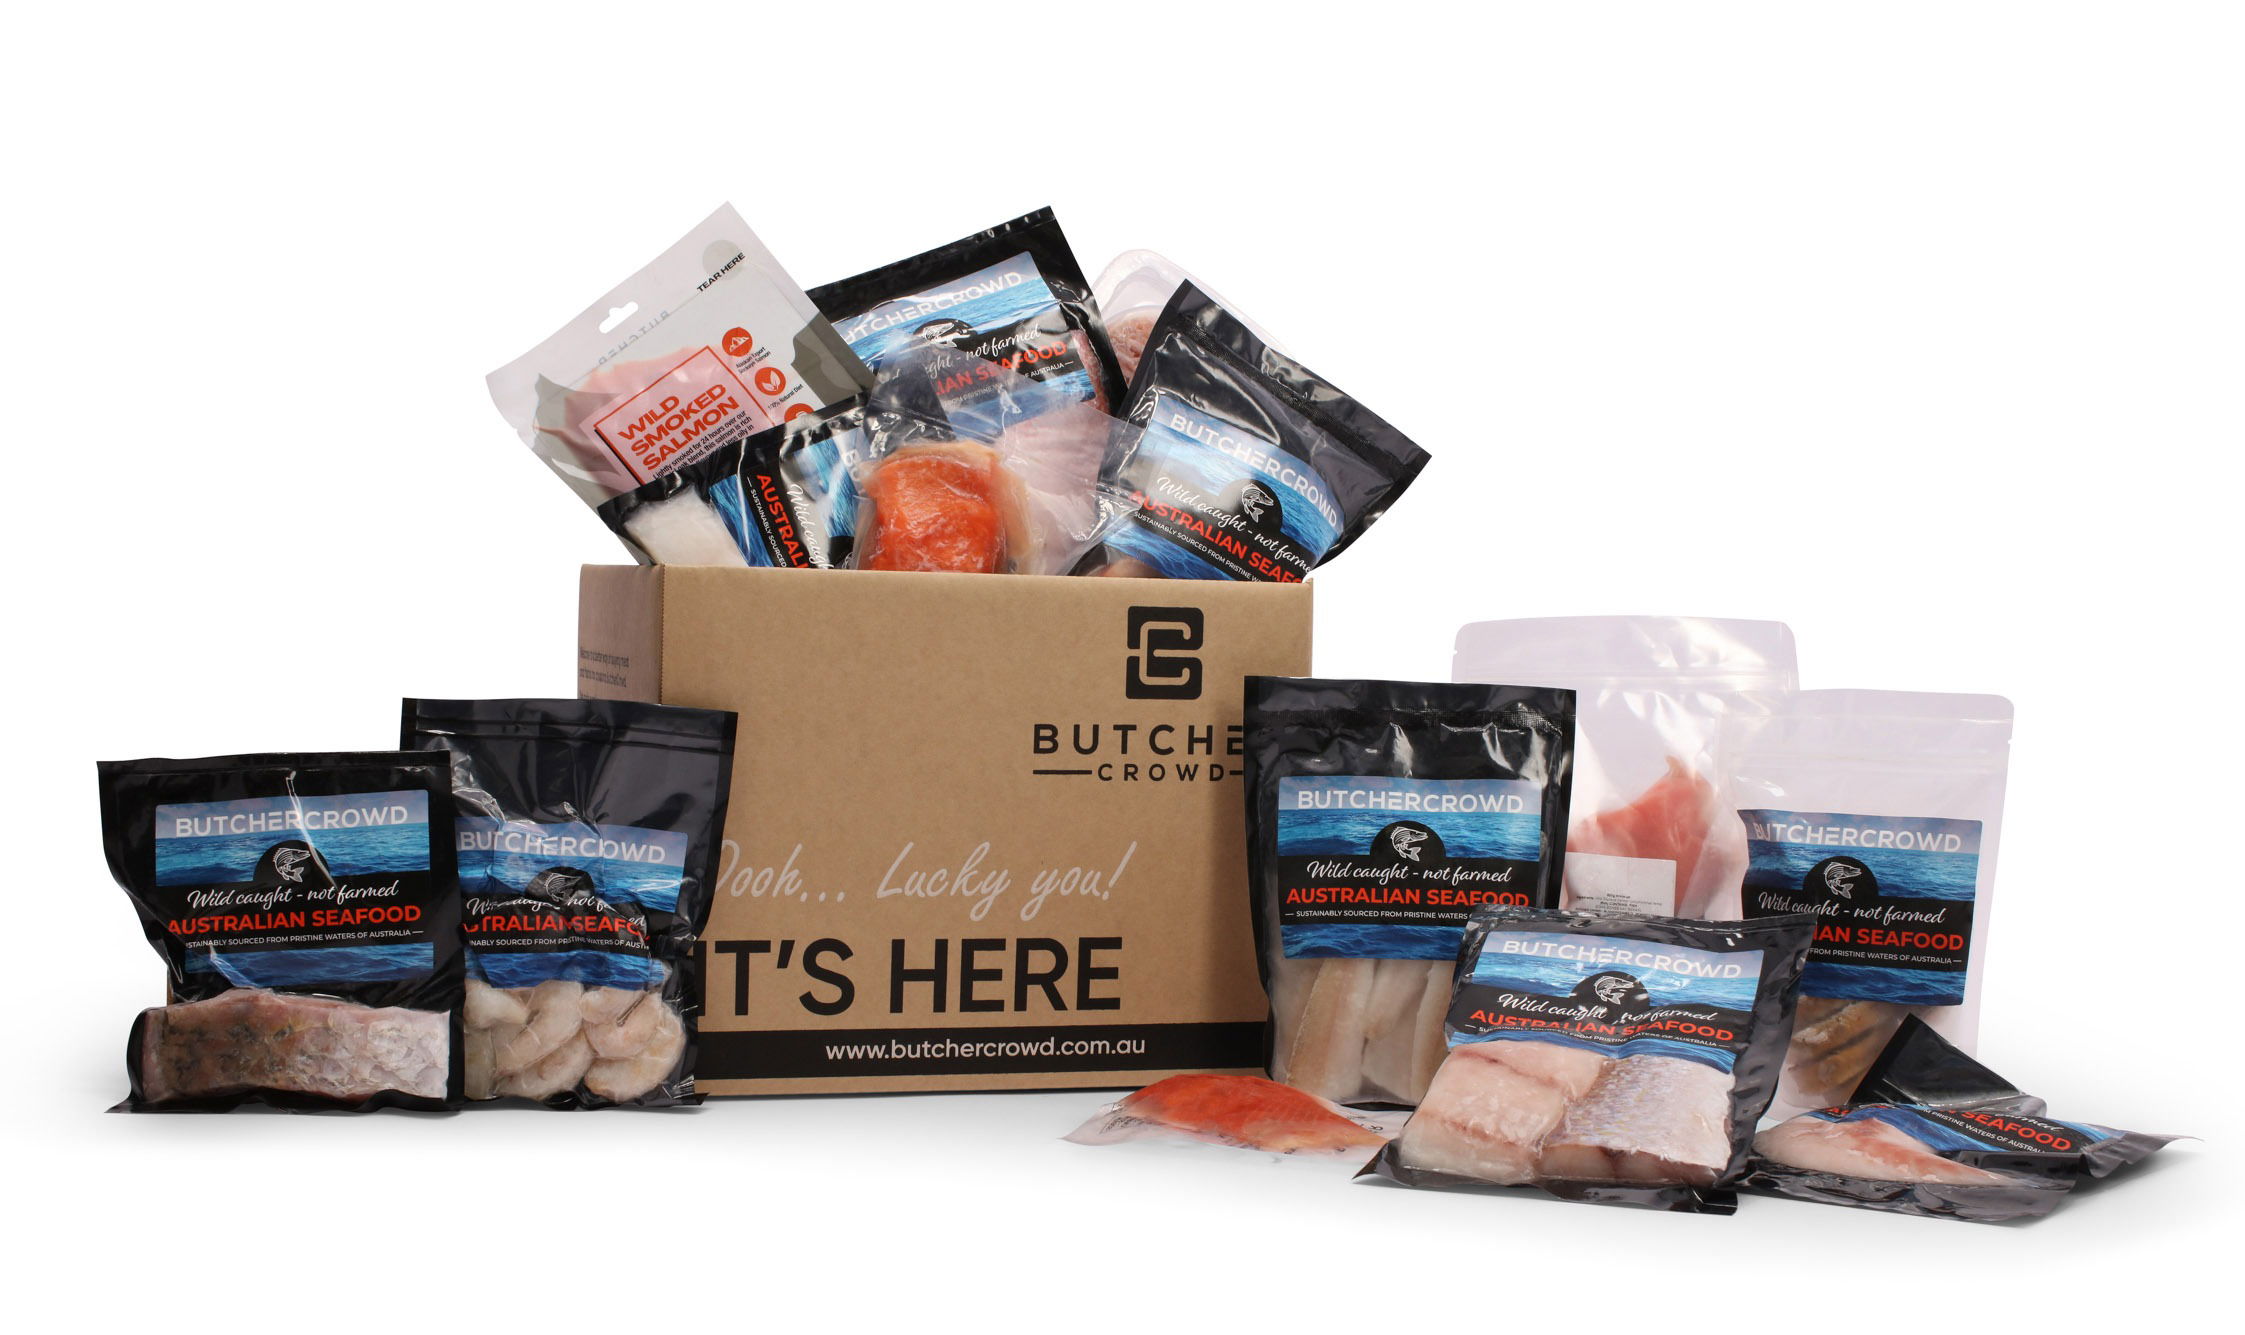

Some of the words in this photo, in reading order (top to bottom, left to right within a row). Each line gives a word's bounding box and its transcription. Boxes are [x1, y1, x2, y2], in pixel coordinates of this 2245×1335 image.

[697, 272, 722, 292] TEAR
[720, 252, 746, 275] HERE
[844, 271, 1022, 343] UTCHERCROWD
[965, 340, 990, 359] not
[992, 324, 1041, 356] farmed
[1030, 363, 1065, 378] AUSTRALIA
[618, 396, 680, 440] WILD
[631, 384, 726, 456] SMOKED
[642, 396, 739, 470] SALMON
[705, 441, 715, 451] this
[715, 428, 735, 444] salmon
[741, 416, 751, 426] rich
[737, 428, 748, 438] oily
[652, 463, 673, 480] Lightly
[671, 447, 693, 465] smoked
[693, 441, 702, 450] for
[701, 436, 709, 444] 24
[709, 425, 725, 439] hours
[725, 417, 737, 428] over
[737, 411, 746, 419] our
[1168, 413, 1337, 528] BUTCHERCROWD
[750, 488, 772, 536] SUSTAINABLY
[768, 535, 787, 568] SOURCED
[757, 475, 809, 568] AUSTRALI
[787, 484, 815, 529] Wild
[804, 530, 834, 569] caugh
[1130, 490, 1248, 559] AUSTRALIAN
[1248, 551, 1302, 583] SEAF
[1157, 476, 1195, 506] Wild
[1197, 501, 1246, 532] caught
[1254, 533, 1279, 551] not
[1274, 545, 1312, 574] farme
[1134, 511, 1177, 535] SUSTAINABLY
[1177, 531, 1208, 552] SOURCED
[1207, 547, 1226, 564] FROM
[1225, 559, 1252, 580] PRISTINE
[1033, 723, 1244, 756] BUTCHE
[1097, 763, 1225, 782] CROWD
[1298, 790, 1524, 813] BUTCHERCROWD
[175, 806, 408, 838] BUTCHERCROWD
[1755, 823, 1961, 853] BUTCHERCROWD
[459, 831, 666, 864] BUTCHERCOWD
[876, 841, 1012, 922] Lucky
[1019, 841, 1138, 922] you!
[1306, 860, 1352, 879] Wild
[1352, 864, 1409, 885] caught
[1422, 866, 1450, 880] not
[1451, 867, 1513, 886] farmed
[187, 888, 234, 909] Wild
[235, 885, 293, 911] caught
[307, 886, 336, 901] not
[336, 880, 399, 906] farmed
[1286, 887, 1421, 905] AUSTRALIAN
[1427, 889, 1529, 907] SEAFOOD
[1758, 891, 1791, 912] Wild
[1854, 906, 1883, 920] not
[1883, 906, 1947, 926] farmed
[168, 910, 306, 935] AUSTRALIAN
[311, 905, 422, 927] SEAFOOD
[571, 915, 648, 938] SEAFO
[1296, 910, 1342, 918] SUSTAINABLY
[1343, 910, 1379, 918] SOURCED
[1403, 911, 1436, 919] PRISTINE
[185, 939, 227, 949] STAINABLY
[228, 937, 265, 946] SOURCED
[290, 933, 324, 942] PRISTINE
[324, 931, 354, 941] WATERS
[355, 931, 368, 939] OF
[368, 929, 411, 938] AUSTRALIA
[496, 938, 533, 946] SOURCED
[1857, 928, 1964, 951] SEAFOOD
[1502, 940, 1742, 979] BUTCHERCROWD
[1809, 948, 1831, 956] FROM
[1832, 949, 1866, 959] PRISTINE
[1867, 951, 1898, 961] WATERS
[1899, 954, 1911, 962] OF
[1911, 955, 1952, 964] AUSTRALIA
[693, 938, 856, 1017] IT'S
[889, 936, 1123, 1015] HERE
[1497, 993, 1549, 1012] Wild
[1548, 1004, 1608, 1021] caught
[1650, 1009, 1718, 1021] farmed
[1470, 1009, 1616, 1035] AUSTRALIAN
[1621, 1020, 1733, 1041] SEAFOOD
[1674, 1036, 1717, 1046] AUSTRALIA
[825, 1036, 1146, 1061] www.butchercrowd.com.au
[1932, 1111, 1965, 1127] PRISTINE
[1966, 1123, 1996, 1138] WATERS
[1997, 1135, 2008, 1143] OF
[2008, 1140, 2047, 1153] AUSTRAL
[1960, 1112, 2071, 1150] SEAFOOD
